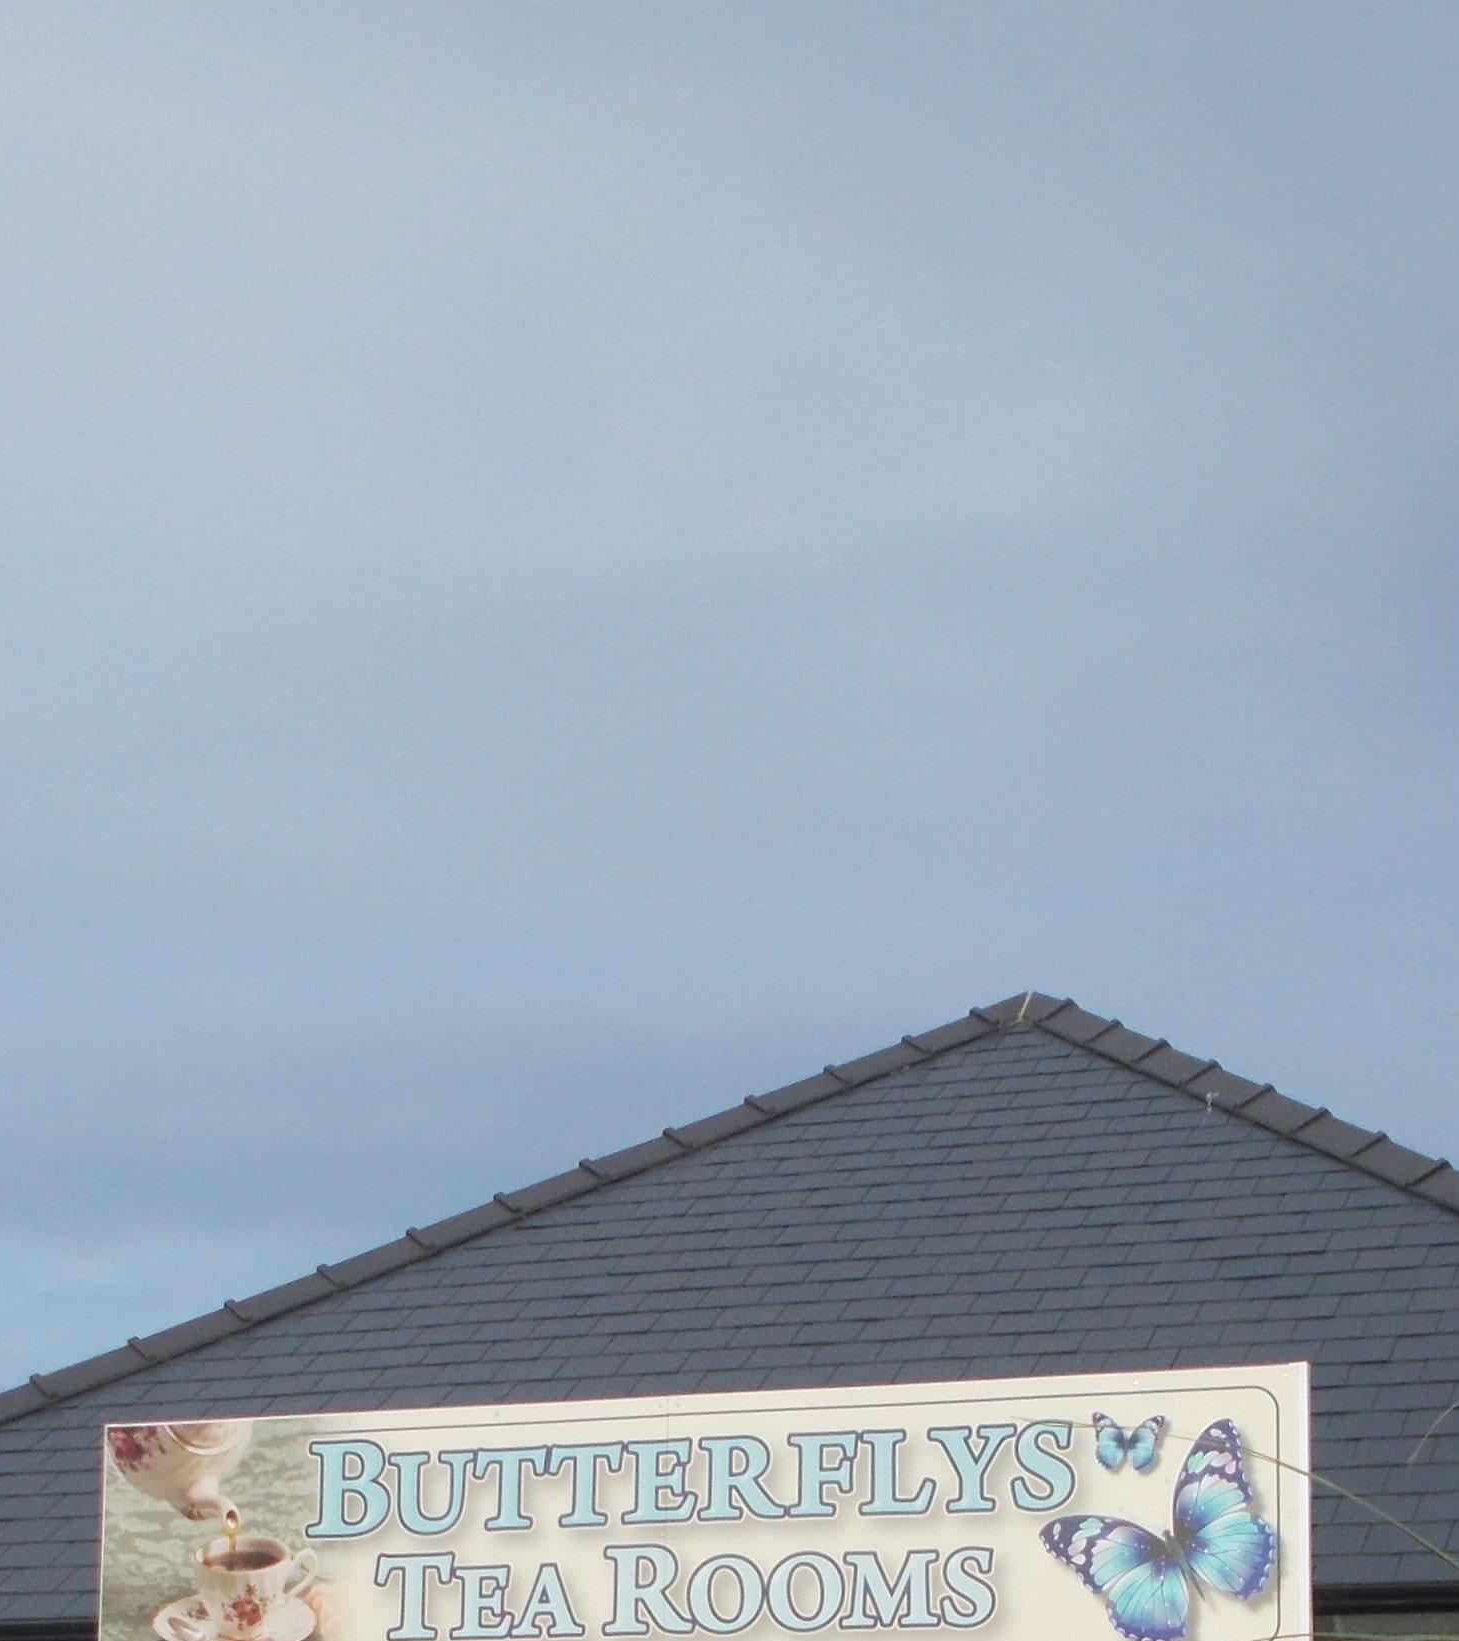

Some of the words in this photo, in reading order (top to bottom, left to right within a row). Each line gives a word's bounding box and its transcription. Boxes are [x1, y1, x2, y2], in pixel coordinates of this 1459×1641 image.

[305, 1419, 1077, 1538] BUTTERFLYS
[375, 1550, 586, 1641] TEA
[602, 1543, 995, 1638] ROOMS
